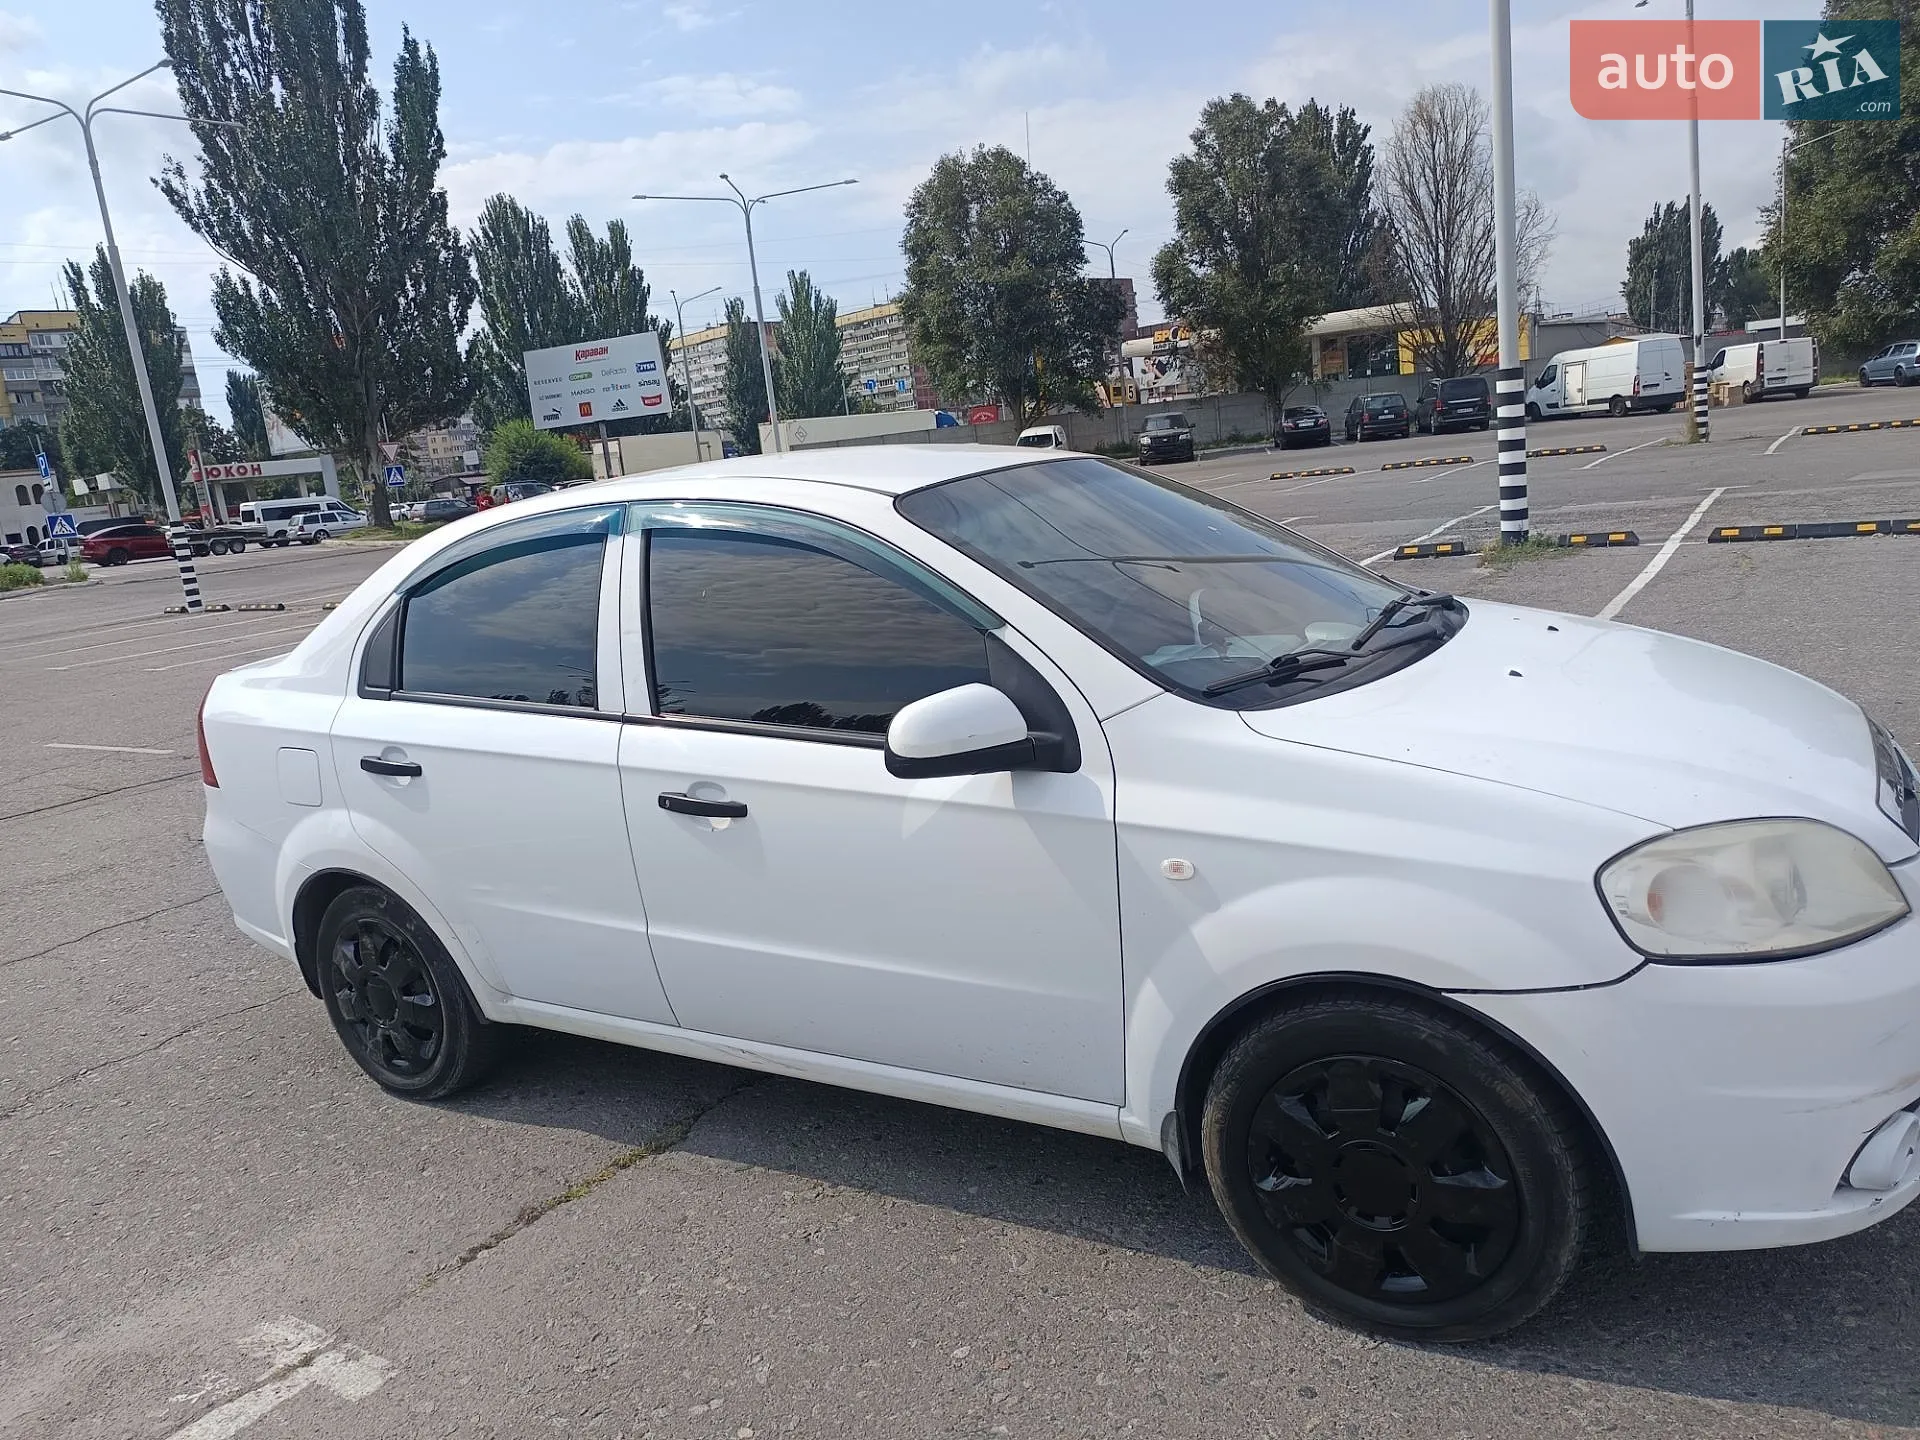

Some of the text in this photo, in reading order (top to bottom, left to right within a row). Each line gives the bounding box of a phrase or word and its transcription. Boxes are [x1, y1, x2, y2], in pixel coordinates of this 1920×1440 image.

[575, 345, 609, 361] Караван
[638, 379, 660, 387] sinsay
[570, 388, 595, 397] MANGO
[205, 463, 263, 480] ЮКОН
